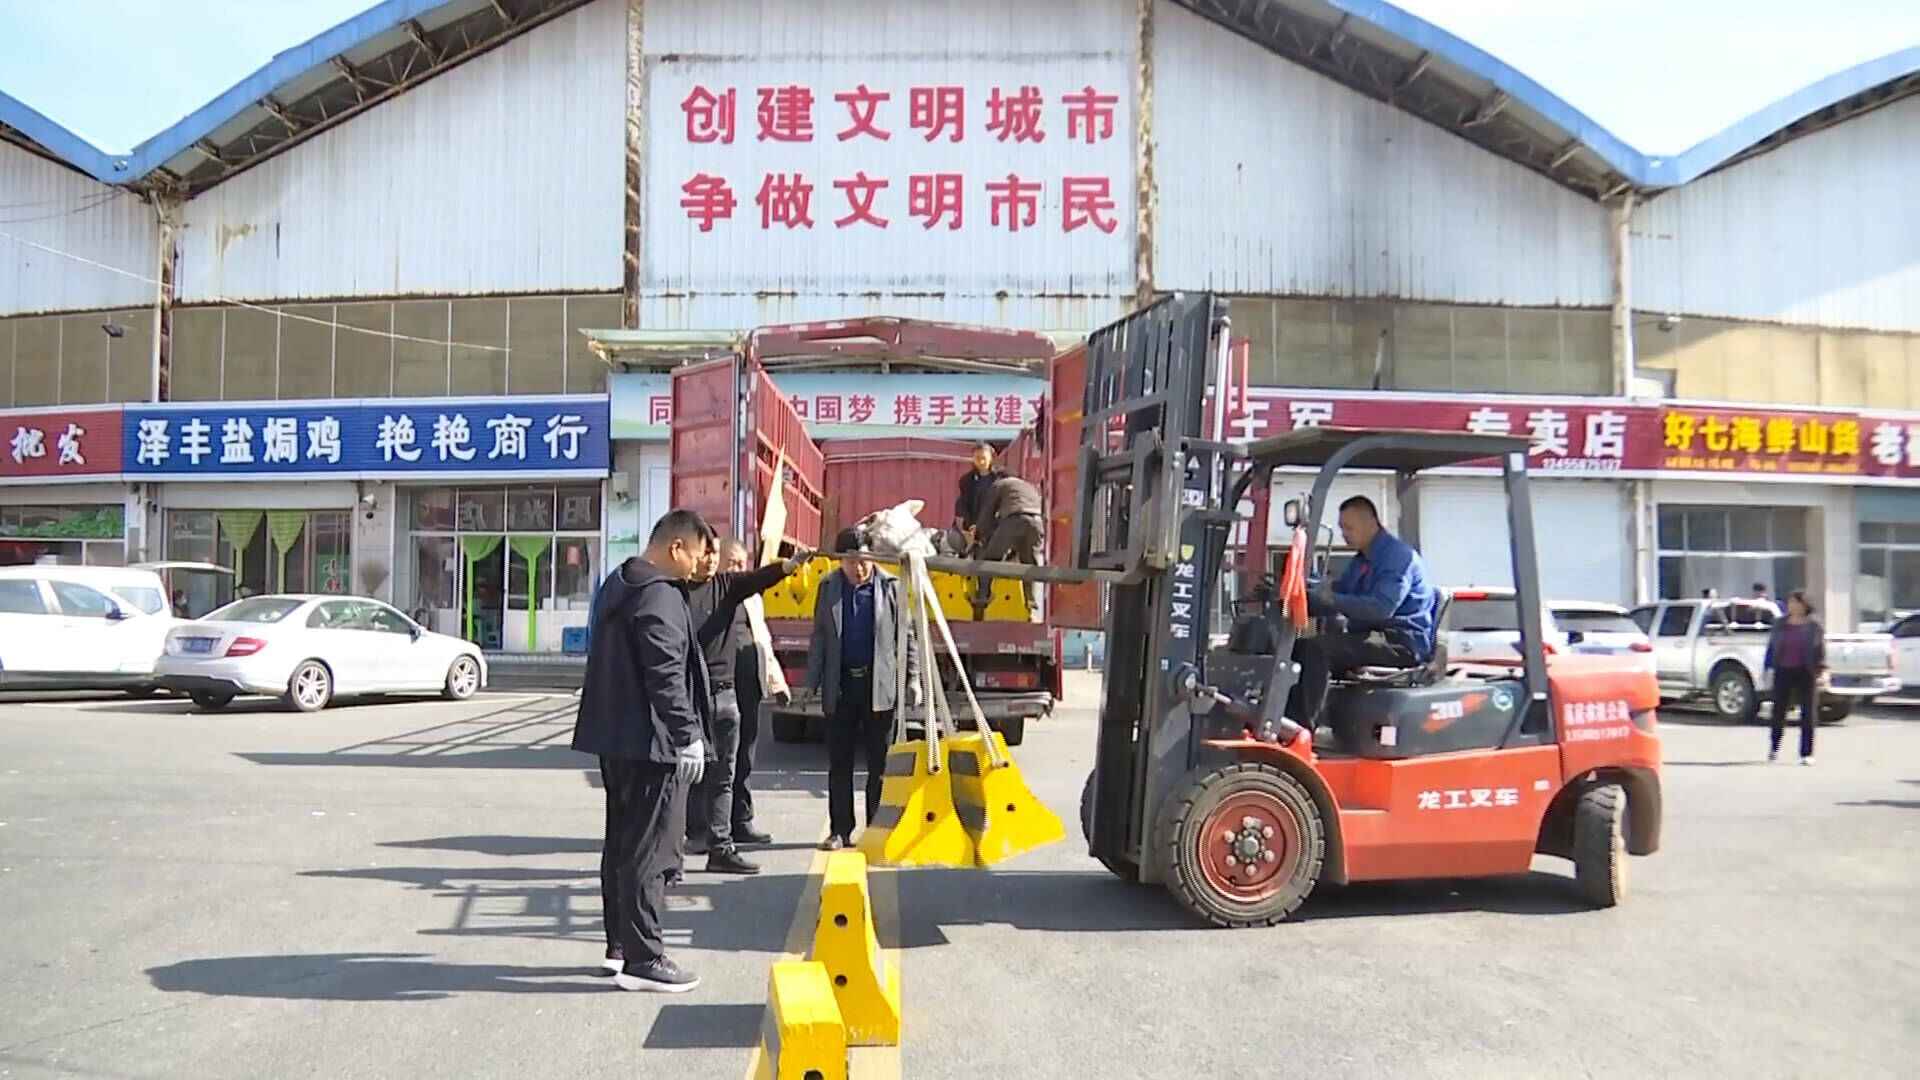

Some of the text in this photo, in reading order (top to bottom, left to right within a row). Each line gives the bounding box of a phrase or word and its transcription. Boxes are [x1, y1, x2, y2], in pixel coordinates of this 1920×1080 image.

[680, 84, 1119, 145] 创建文明城市
[680, 171, 1118, 234] 争做文明市民
[10, 423, 86, 465] 批发
[136, 417, 342, 466] 泽丰盐焗鸡
[374, 412, 590, 462] 艳艳商行
[1169, 563, 1195, 638] 龙工叉车
[1430, 701, 1464, 721] 30
[1417, 788, 1520, 810] 龙工叉车
